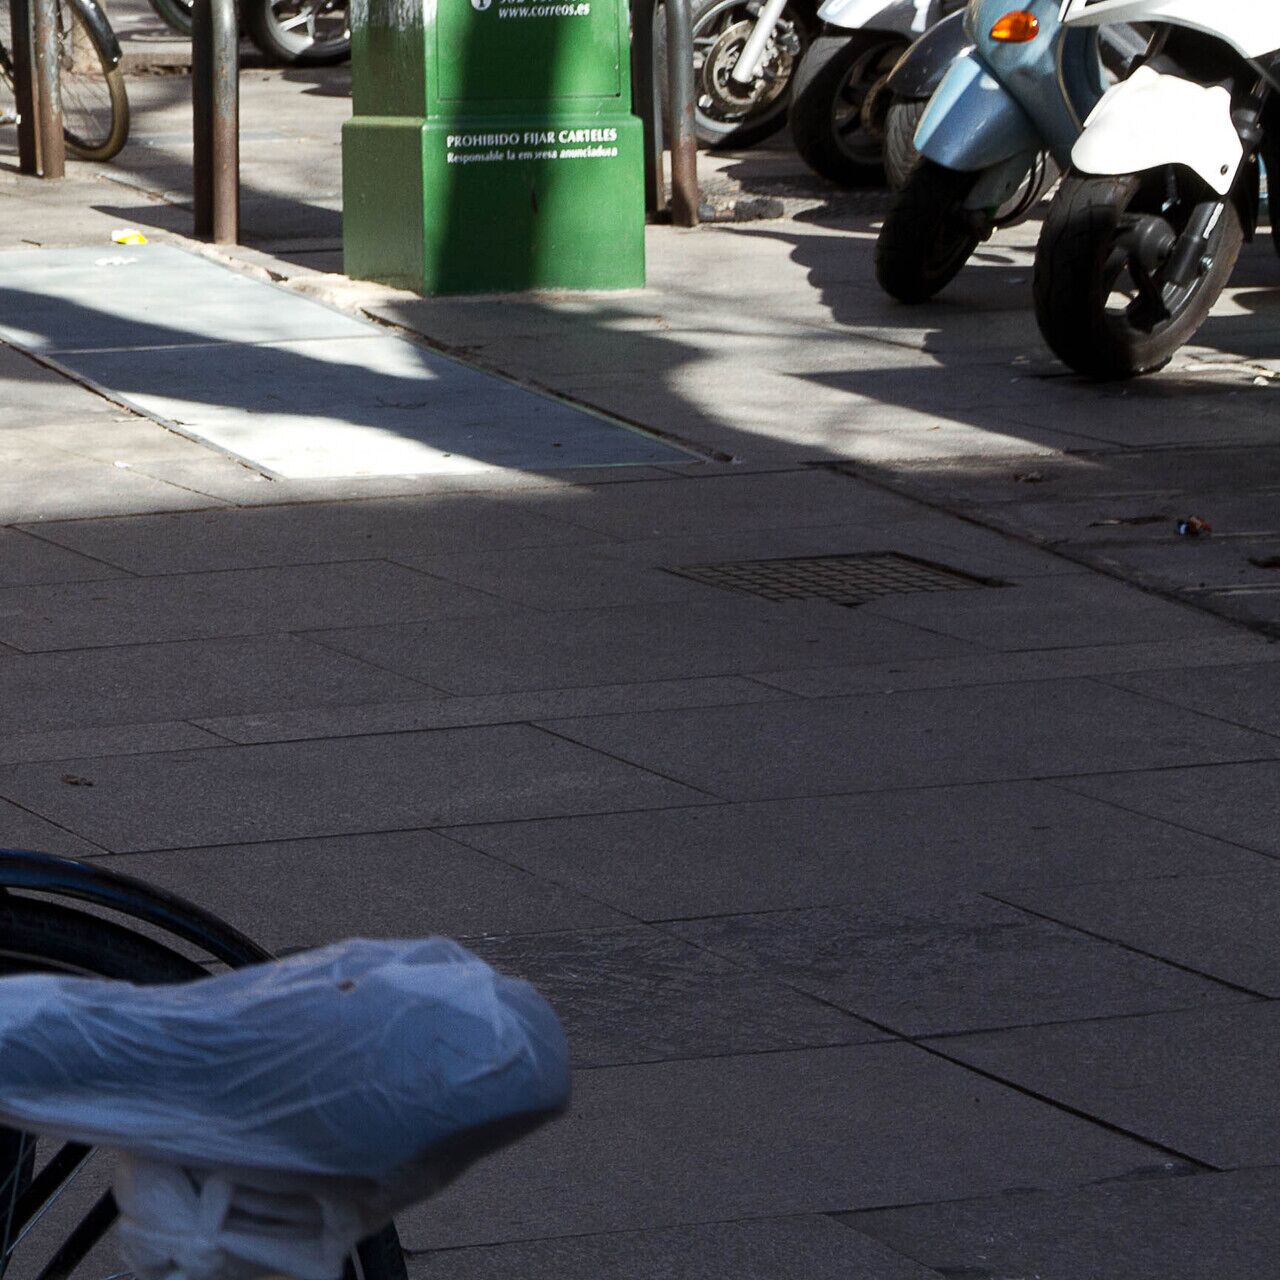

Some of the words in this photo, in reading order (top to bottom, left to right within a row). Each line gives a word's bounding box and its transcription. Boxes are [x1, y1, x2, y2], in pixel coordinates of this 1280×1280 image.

[498, 3, 590, 19] www.correos.es
[446, 133, 520, 148] PROHIBIDO
[523, 131, 556, 146] FIJAR
[558, 128, 618, 144] CARTELES
[446, 150, 504, 165] Responsable
[506, 149, 516, 160] la
